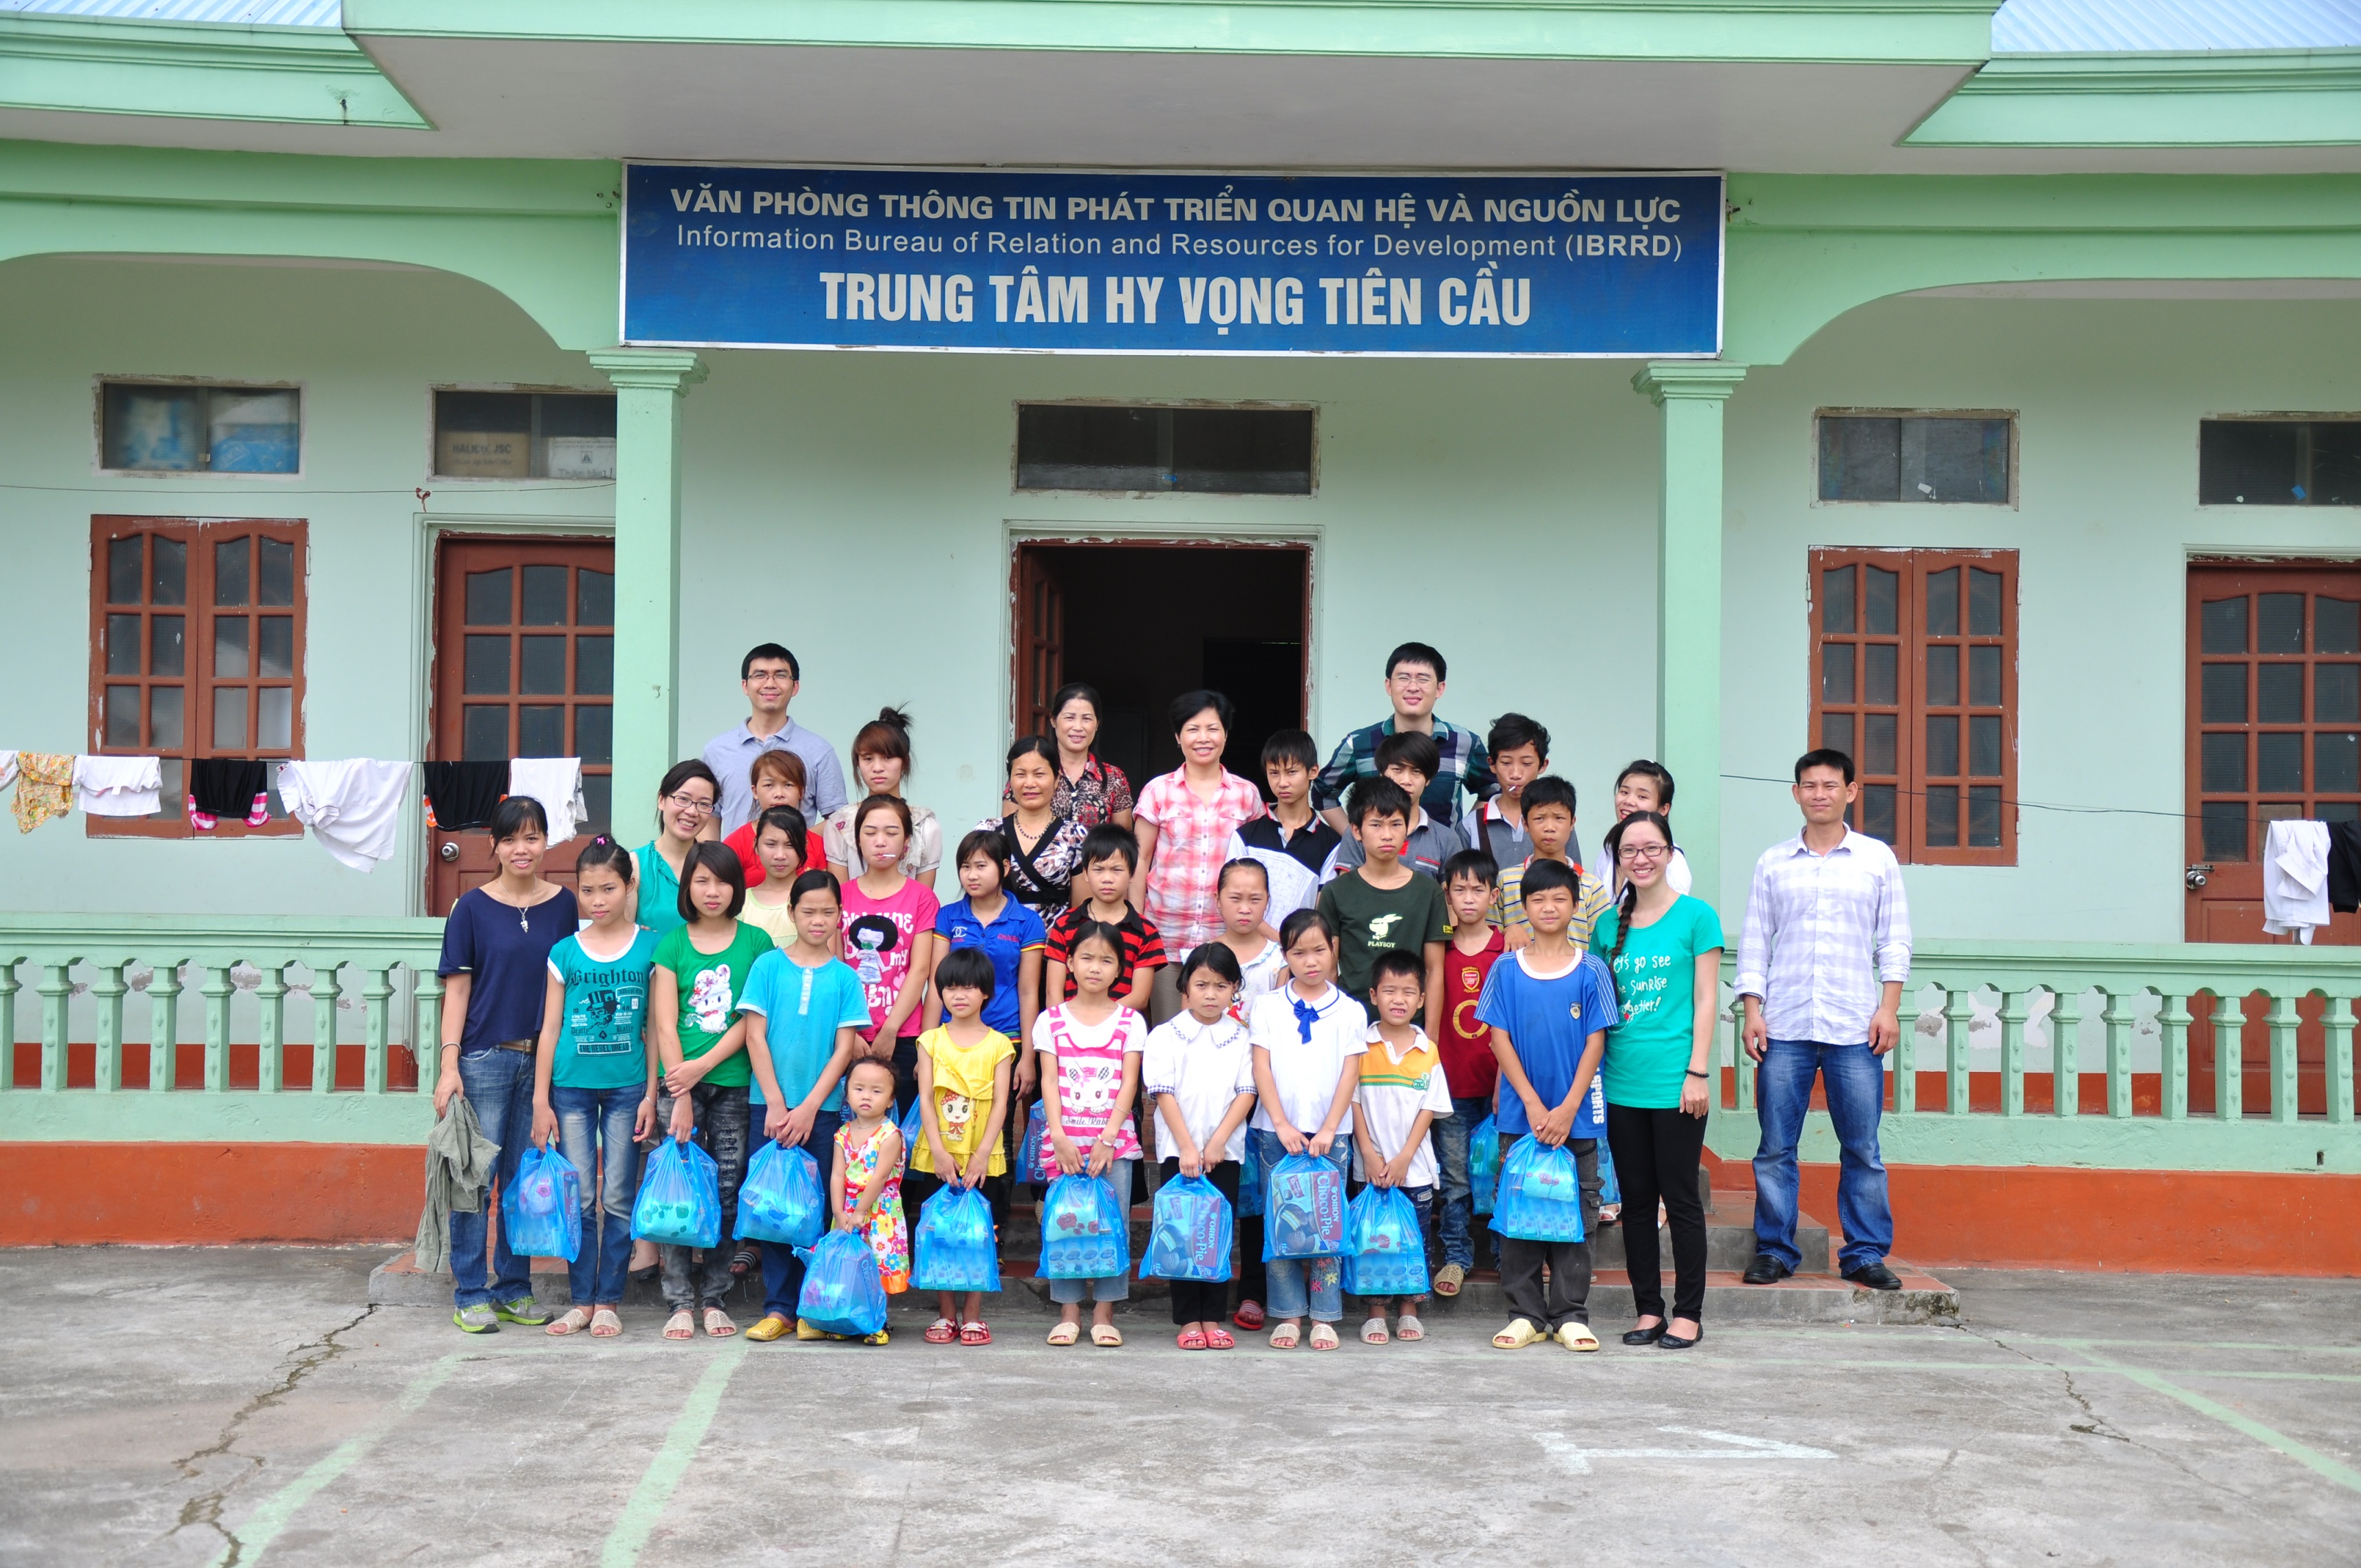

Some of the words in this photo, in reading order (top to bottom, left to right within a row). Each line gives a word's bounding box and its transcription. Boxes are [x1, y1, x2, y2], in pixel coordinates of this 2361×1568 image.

[672, 184, 741, 213] VĂN
[754, 186, 868, 217] PHÒNG
[879, 190, 993, 219] THÔNG
[1004, 197, 1056, 219] TIN
[1068, 192, 1155, 220] PHÁT
[1164, 185, 1257, 221] TRIỂN
[1268, 199, 1363, 222] QUAN
[1376, 193, 1416, 228] HỆ
[1427, 193, 1474, 222] VÀ
[1485, 189, 1604, 222] NGUỒN
[1616, 197, 1680, 230] LỰC
[679, 225, 833, 250] Information
[846, 229, 942, 253] Bureau
[954, 232, 979, 253] of
[988, 233, 1100, 254] Relation
[1112, 234, 1160, 255] and
[1173, 234, 1318, 256] Resources
[1327, 235, 1364, 256] for
[1375, 235, 1555, 261] Development
[1566, 235, 1681, 262] (IBRRD)
[820, 272, 974, 323] TRUNG
[990, 265, 1089, 324] TÂM
[1106, 276, 1164, 324] HY
[1179, 277, 1303, 336] VỌNG
[1319, 267, 1422, 325] TIÊN
[1440, 261, 1531, 326] CẦU
[890, 949, 908, 966] my
[1634, 956, 1647, 974] go
[1652, 955, 1671, 969] see
[570, 968, 644, 987] Brighton
[592, 1044, 611, 1053] REBEL
[1590, 1074, 1605, 1124] SPORTS
[1066, 1116, 1086, 1126] Smile
[1331, 1194, 1340, 1223] ORION
[1208, 1220, 1217, 1249] ORION
